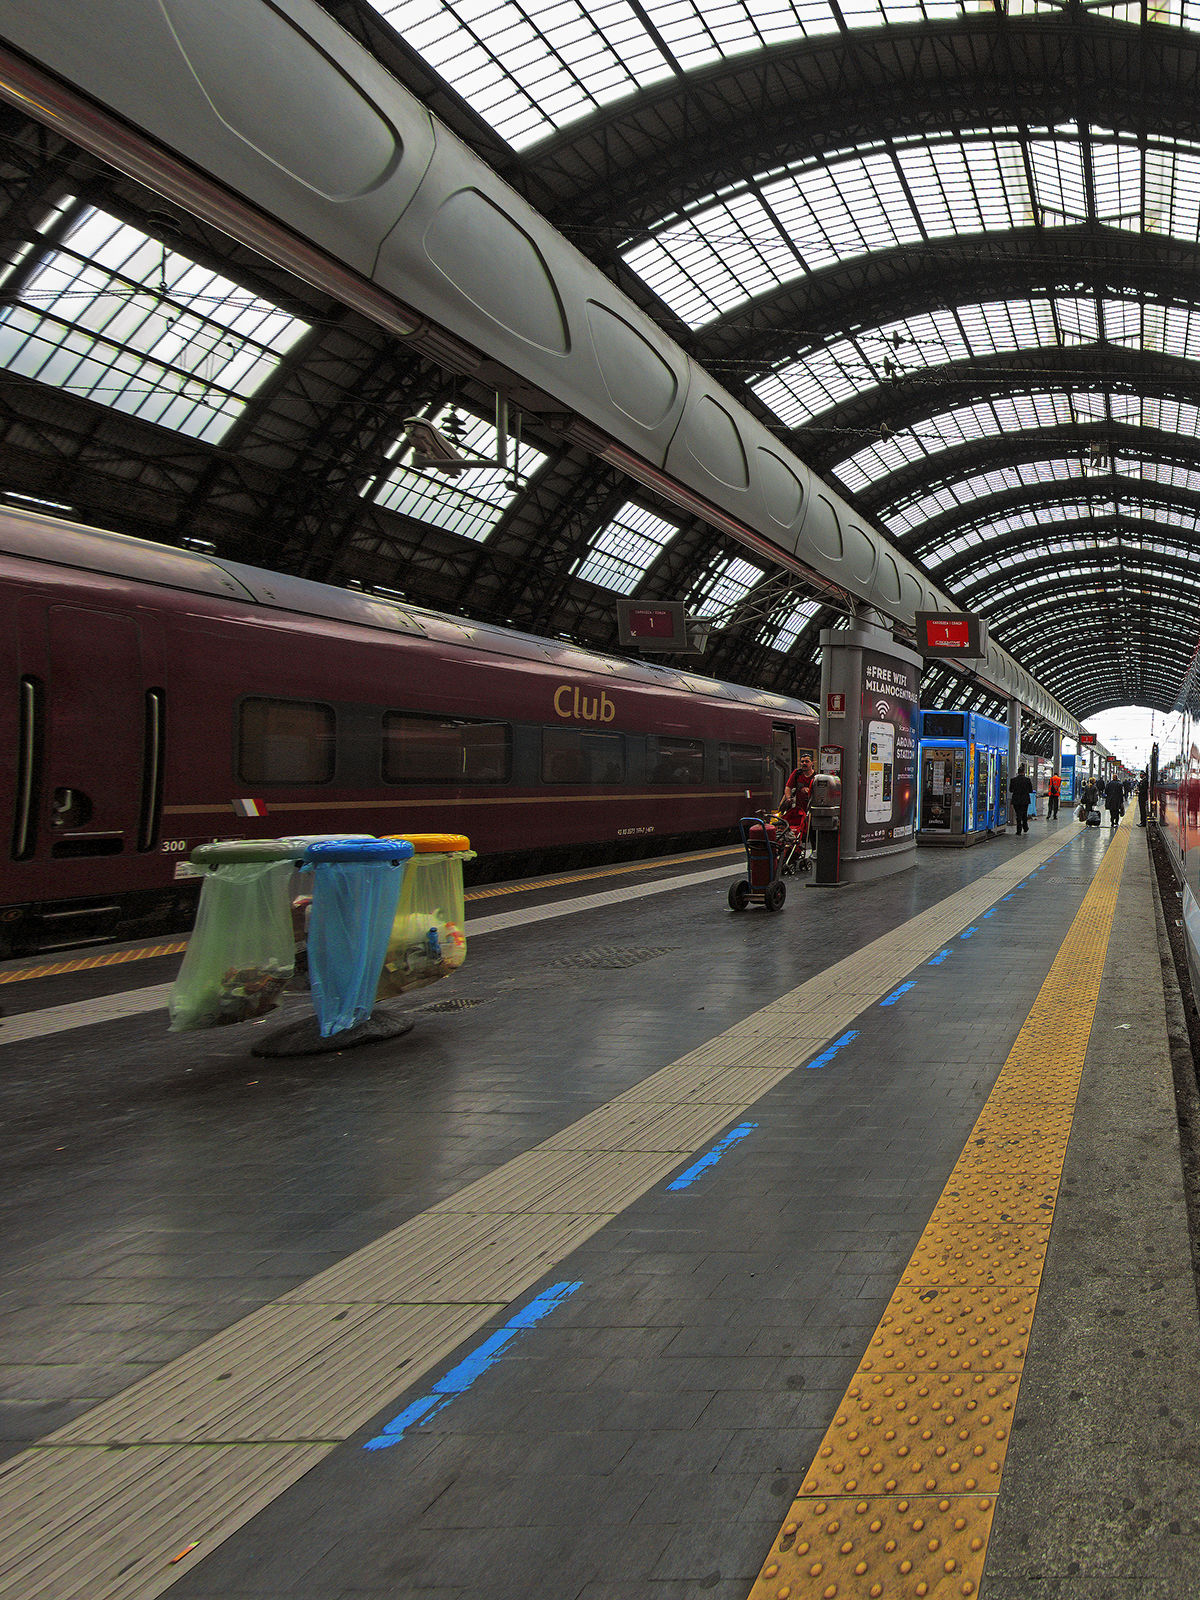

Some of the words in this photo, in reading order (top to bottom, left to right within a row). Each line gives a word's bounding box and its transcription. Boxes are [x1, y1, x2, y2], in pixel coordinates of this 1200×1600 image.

[944, 628, 949, 638] 1
[866, 665, 892, 682] #FREE
[892, 672, 907, 687] WIFI
[554, 685, 616, 722] Club
[161, 840, 186, 852] 300
